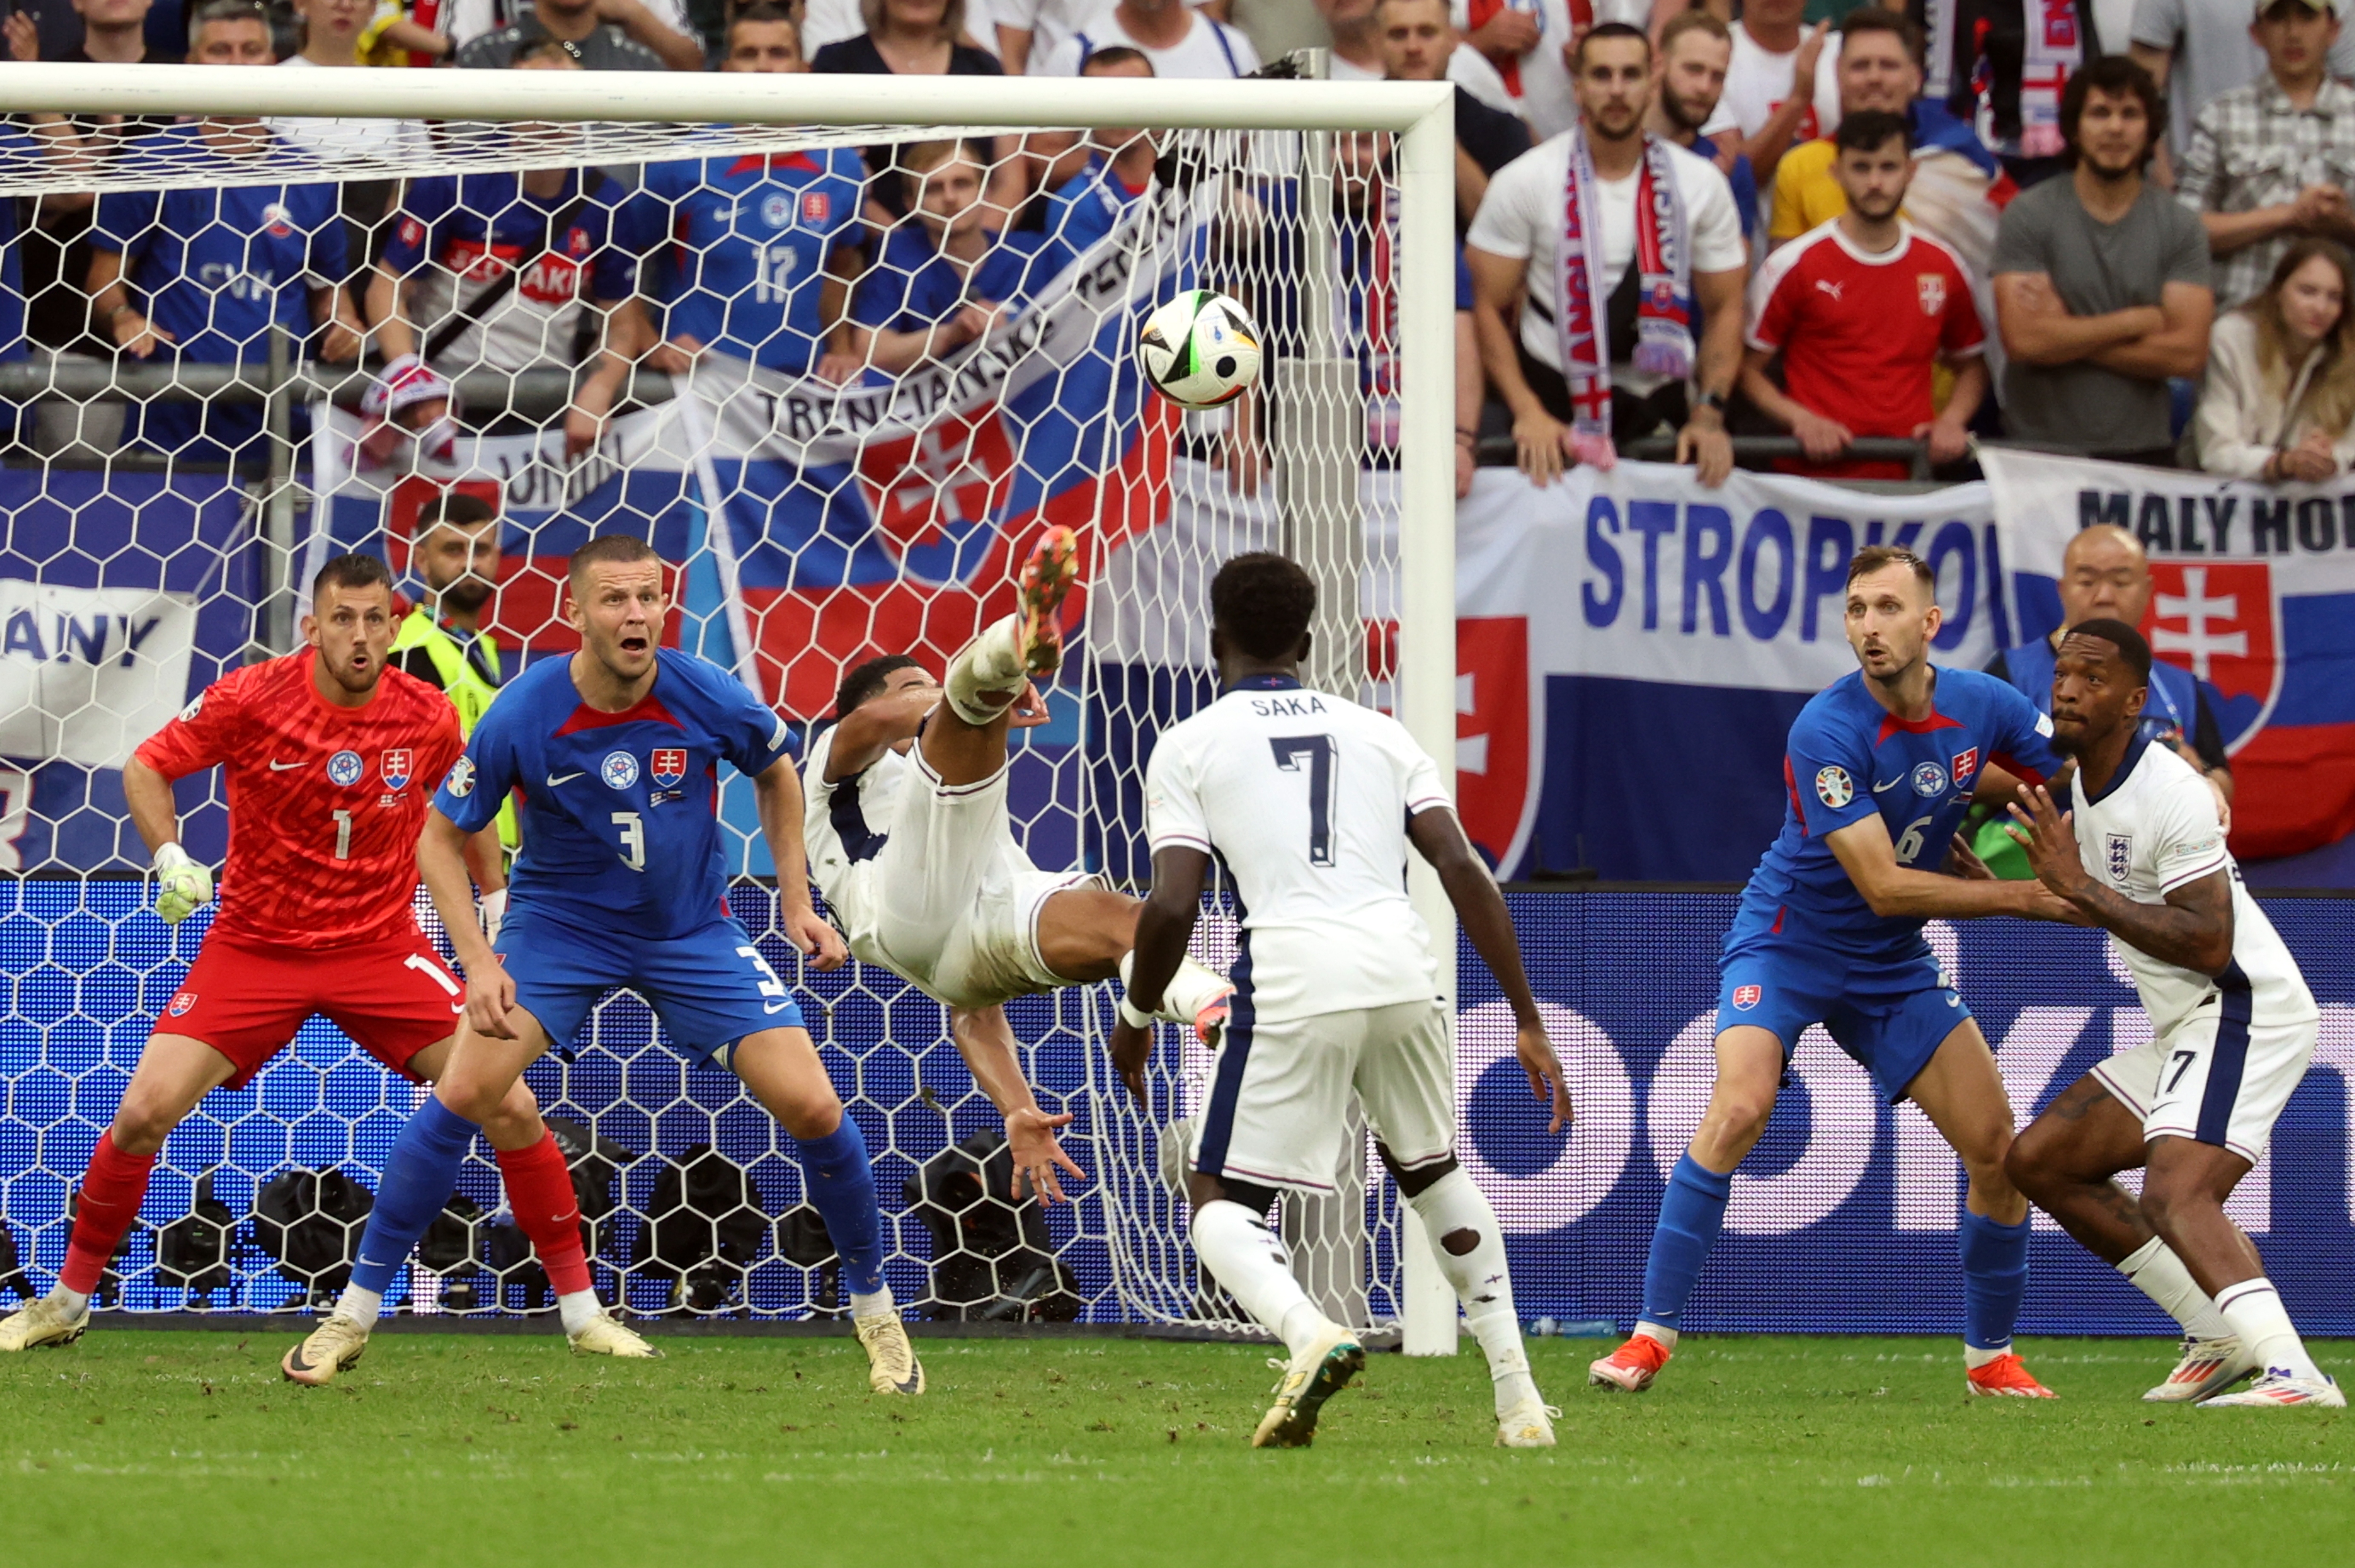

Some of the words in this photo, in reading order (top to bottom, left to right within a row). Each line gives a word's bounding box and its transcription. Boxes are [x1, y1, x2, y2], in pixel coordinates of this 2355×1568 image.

[752, 246, 797, 304] 17
[2079, 481, 2237, 553] MALÝ
[3, 606, 159, 667] ANY
[1251, 695, 1327, 716] SAKA
[1268, 733, 1339, 867] 7
[333, 809, 351, 860] 1
[611, 812, 645, 872] 3
[1895, 816, 1934, 864] 6
[404, 952, 461, 996] 1
[736, 946, 786, 996] 3
[1185, 915, 2355, 1232] ook
[2154, 1051, 2199, 1100] 7
